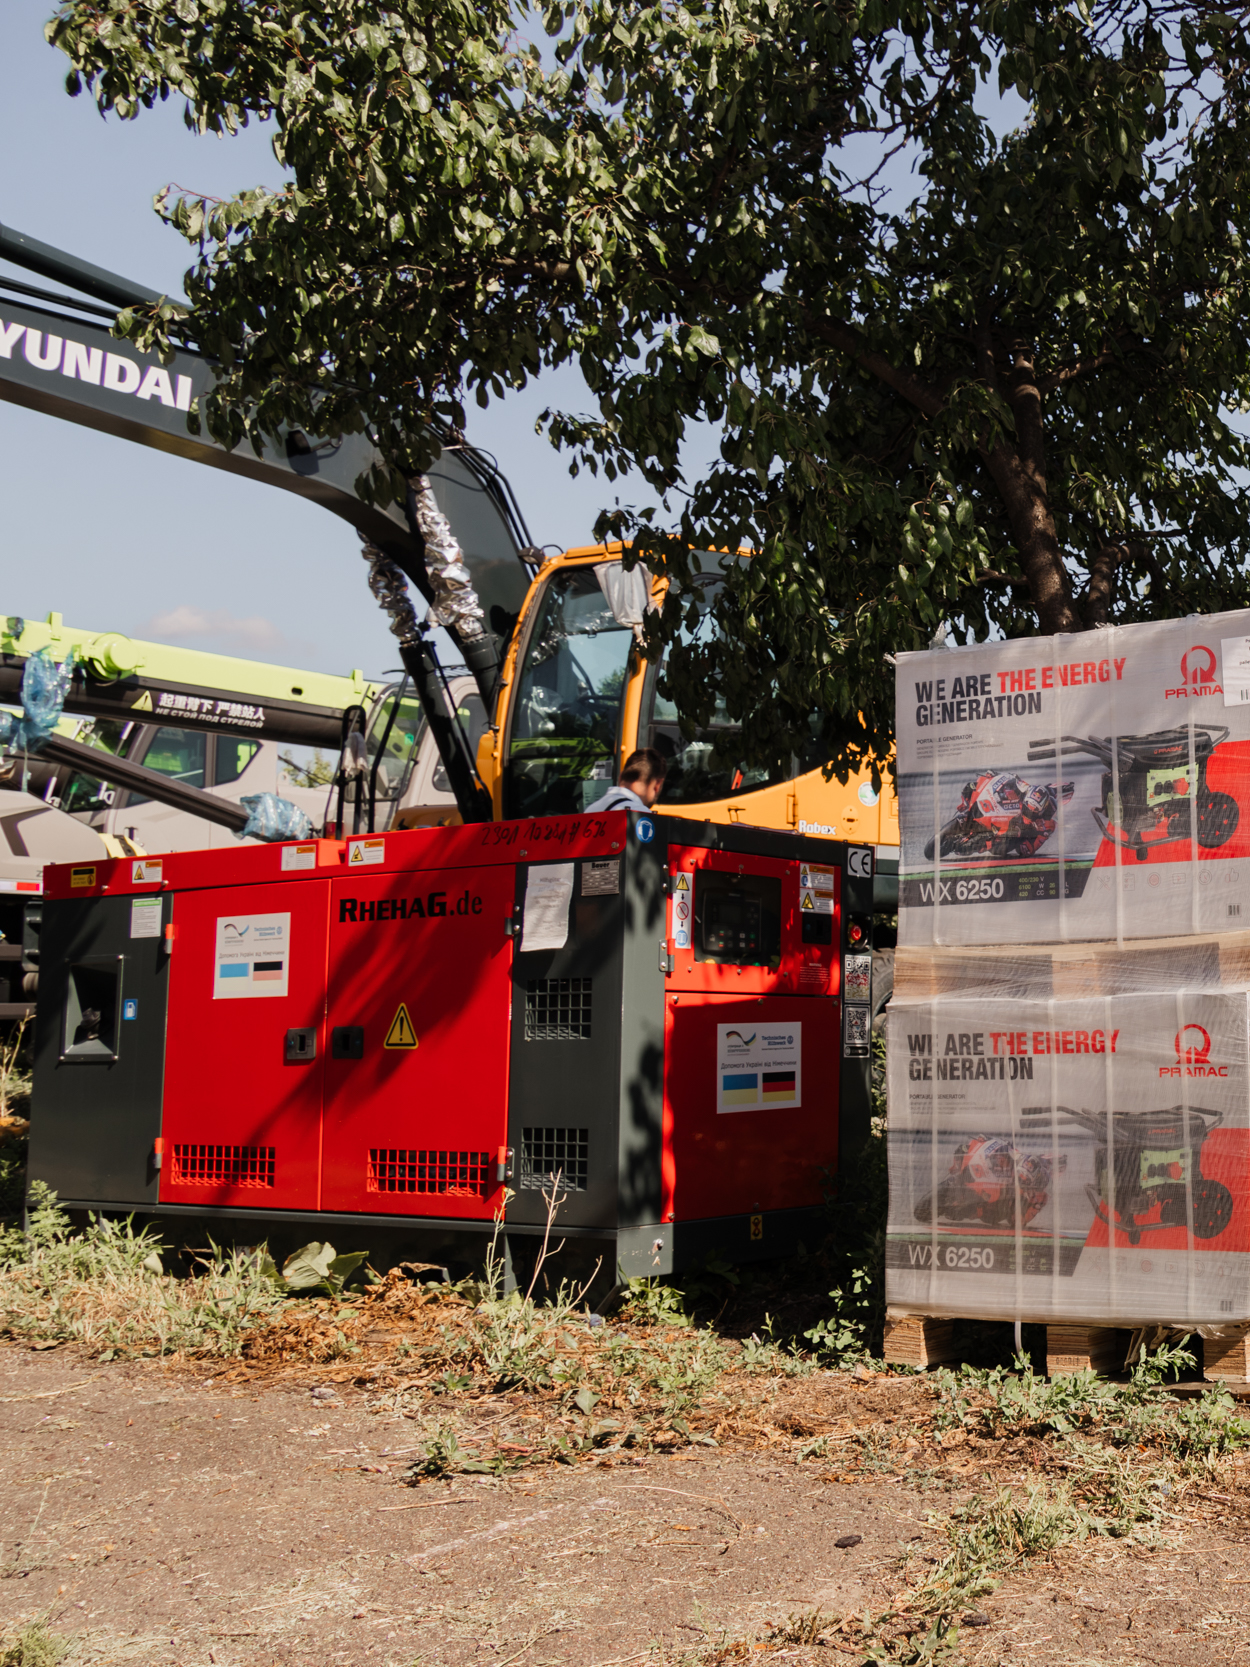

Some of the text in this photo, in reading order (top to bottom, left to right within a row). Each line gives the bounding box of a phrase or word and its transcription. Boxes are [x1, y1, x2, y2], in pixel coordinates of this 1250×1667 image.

[0, 318, 192, 412] YUNDAI
[915, 657, 1127, 703] WE ARE THE ENERGY
[1164, 684, 1224, 700] PRAMA
[155, 707, 264, 729] НЕ СТОЙ ПОД СТРЕЛОЙ
[916, 691, 1042, 727] GENERATION
[942, 734, 972, 742] GENERATOR
[798, 820, 837, 836] Robex
[919, 878, 1004, 902] WX 6250
[944, 1032, 984, 1056] ARE
[989, 1031, 1028, 1055] THE
[1032, 1029, 1120, 1055] ENERGY
[908, 1056, 1034, 1081] GENERATION
[1159, 1066, 1228, 1078] PRAMAC
[908, 1244, 941, 1266] WX
[945, 1246, 994, 1269] 6250
